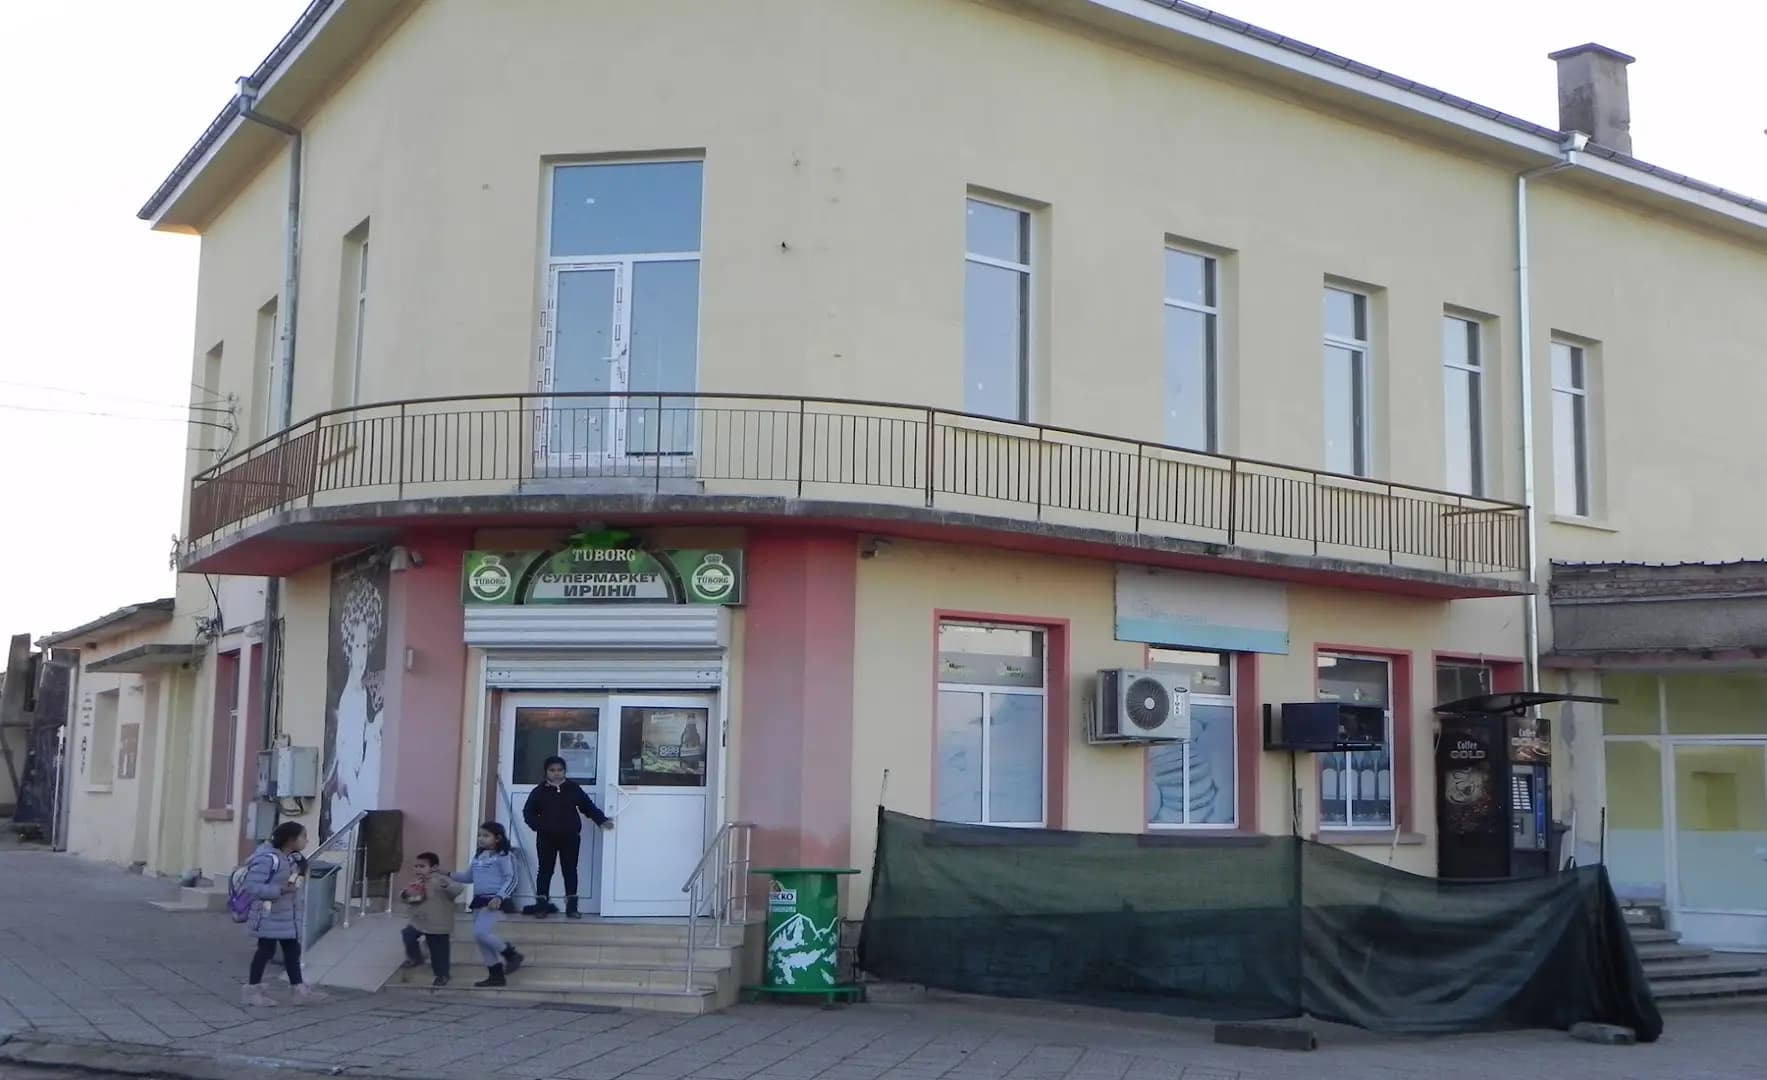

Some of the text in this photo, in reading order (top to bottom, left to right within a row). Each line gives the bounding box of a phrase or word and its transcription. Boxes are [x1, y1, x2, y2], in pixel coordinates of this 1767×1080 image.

[572, 548, 636, 562] TUBORG
[542, 573, 659, 584] СУПЕРМАРКЕТ
[696, 576, 729, 584] TUBORG
[563, 584, 637, 597] ИРИНИ
[1457, 740, 1478, 750] Coffee
[1450, 750, 1485, 759] GOLD
